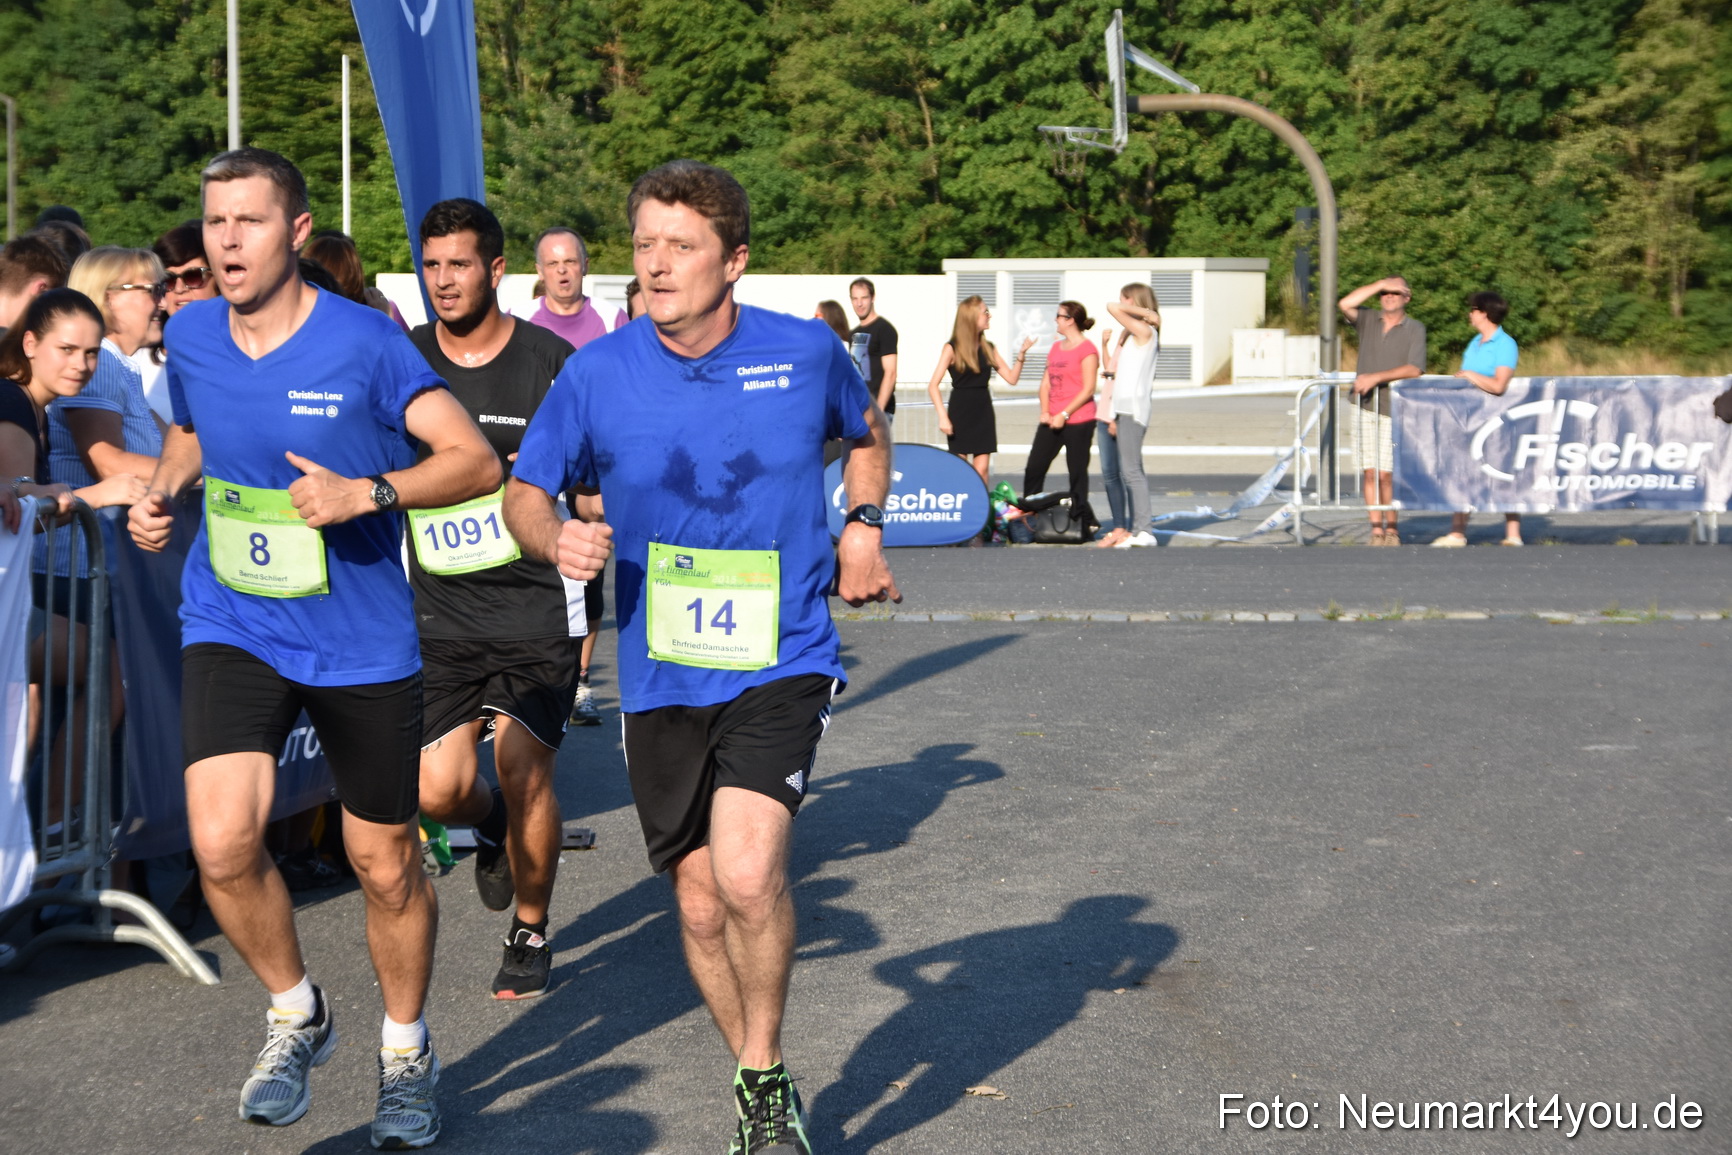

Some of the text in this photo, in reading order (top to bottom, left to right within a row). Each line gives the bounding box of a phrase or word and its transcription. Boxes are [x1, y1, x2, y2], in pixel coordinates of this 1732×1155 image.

[737, 363, 793, 376] Christian Lenz
[743, 380, 776, 391] Allianz
[288, 390, 343, 401] Christian Lenz
[290, 405, 324, 415] Allianz
[487, 415, 527, 426] PFLEIDERER
[1514, 430, 1713, 471] Fischer
[1533, 474, 1697, 491] AUTOMOBILE
[883, 511, 961, 523] UTOMOBILE
[424, 512, 501, 551] 1091
[249, 532, 271, 566] 8
[239, 570, 259, 580] Bernd
[667, 565, 711, 578] firmenlauf
[687, 597, 737, 636] 14
[672, 639, 749, 653] Ehrfried Damaschke
